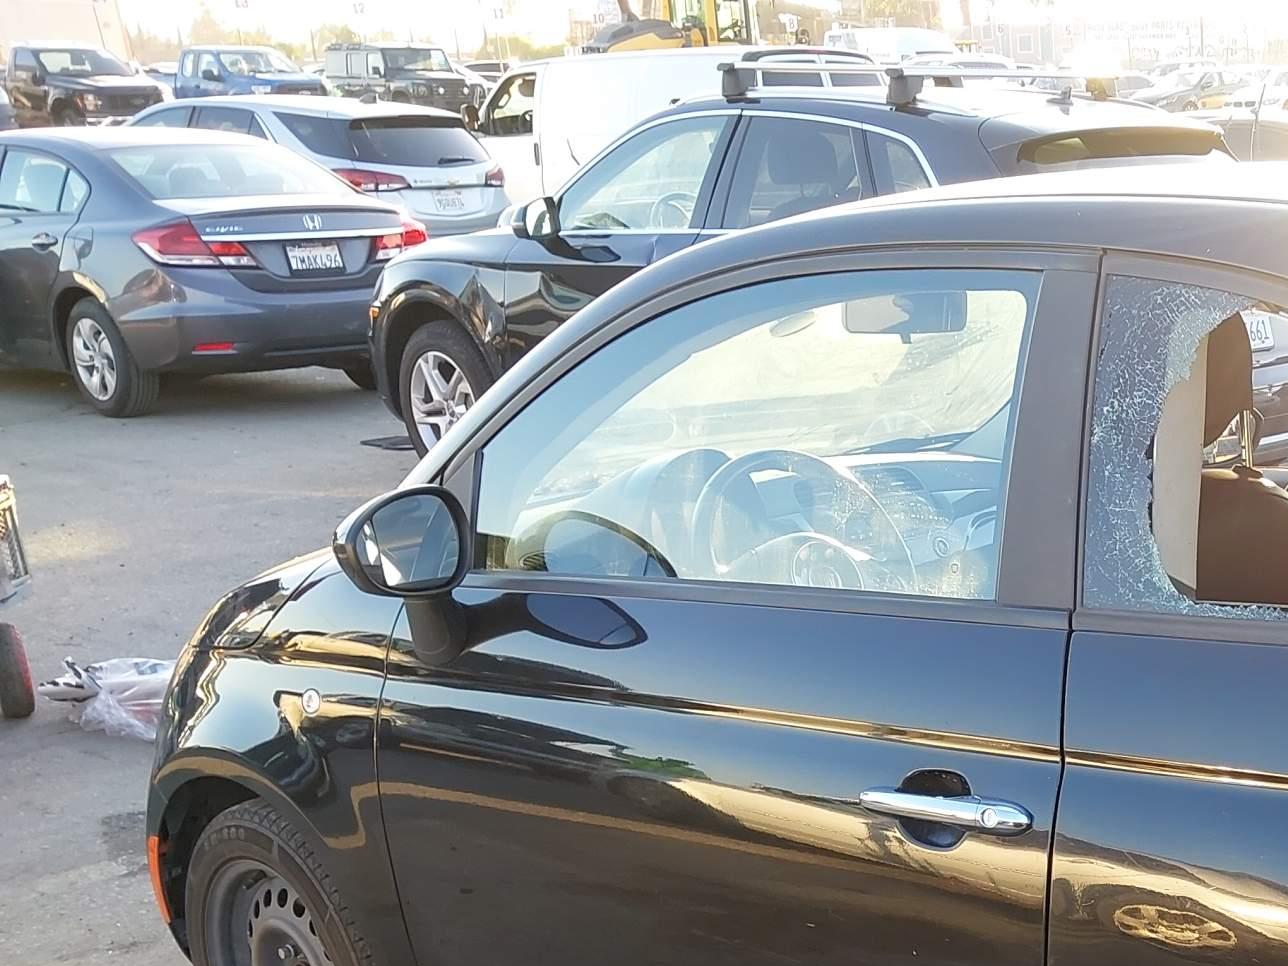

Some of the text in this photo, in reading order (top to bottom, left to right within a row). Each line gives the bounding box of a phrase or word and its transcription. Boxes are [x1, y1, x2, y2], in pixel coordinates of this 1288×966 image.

[352, 2, 366, 15] 12
[493, 8, 505, 20] 11
[592, 14, 605, 24] 10
